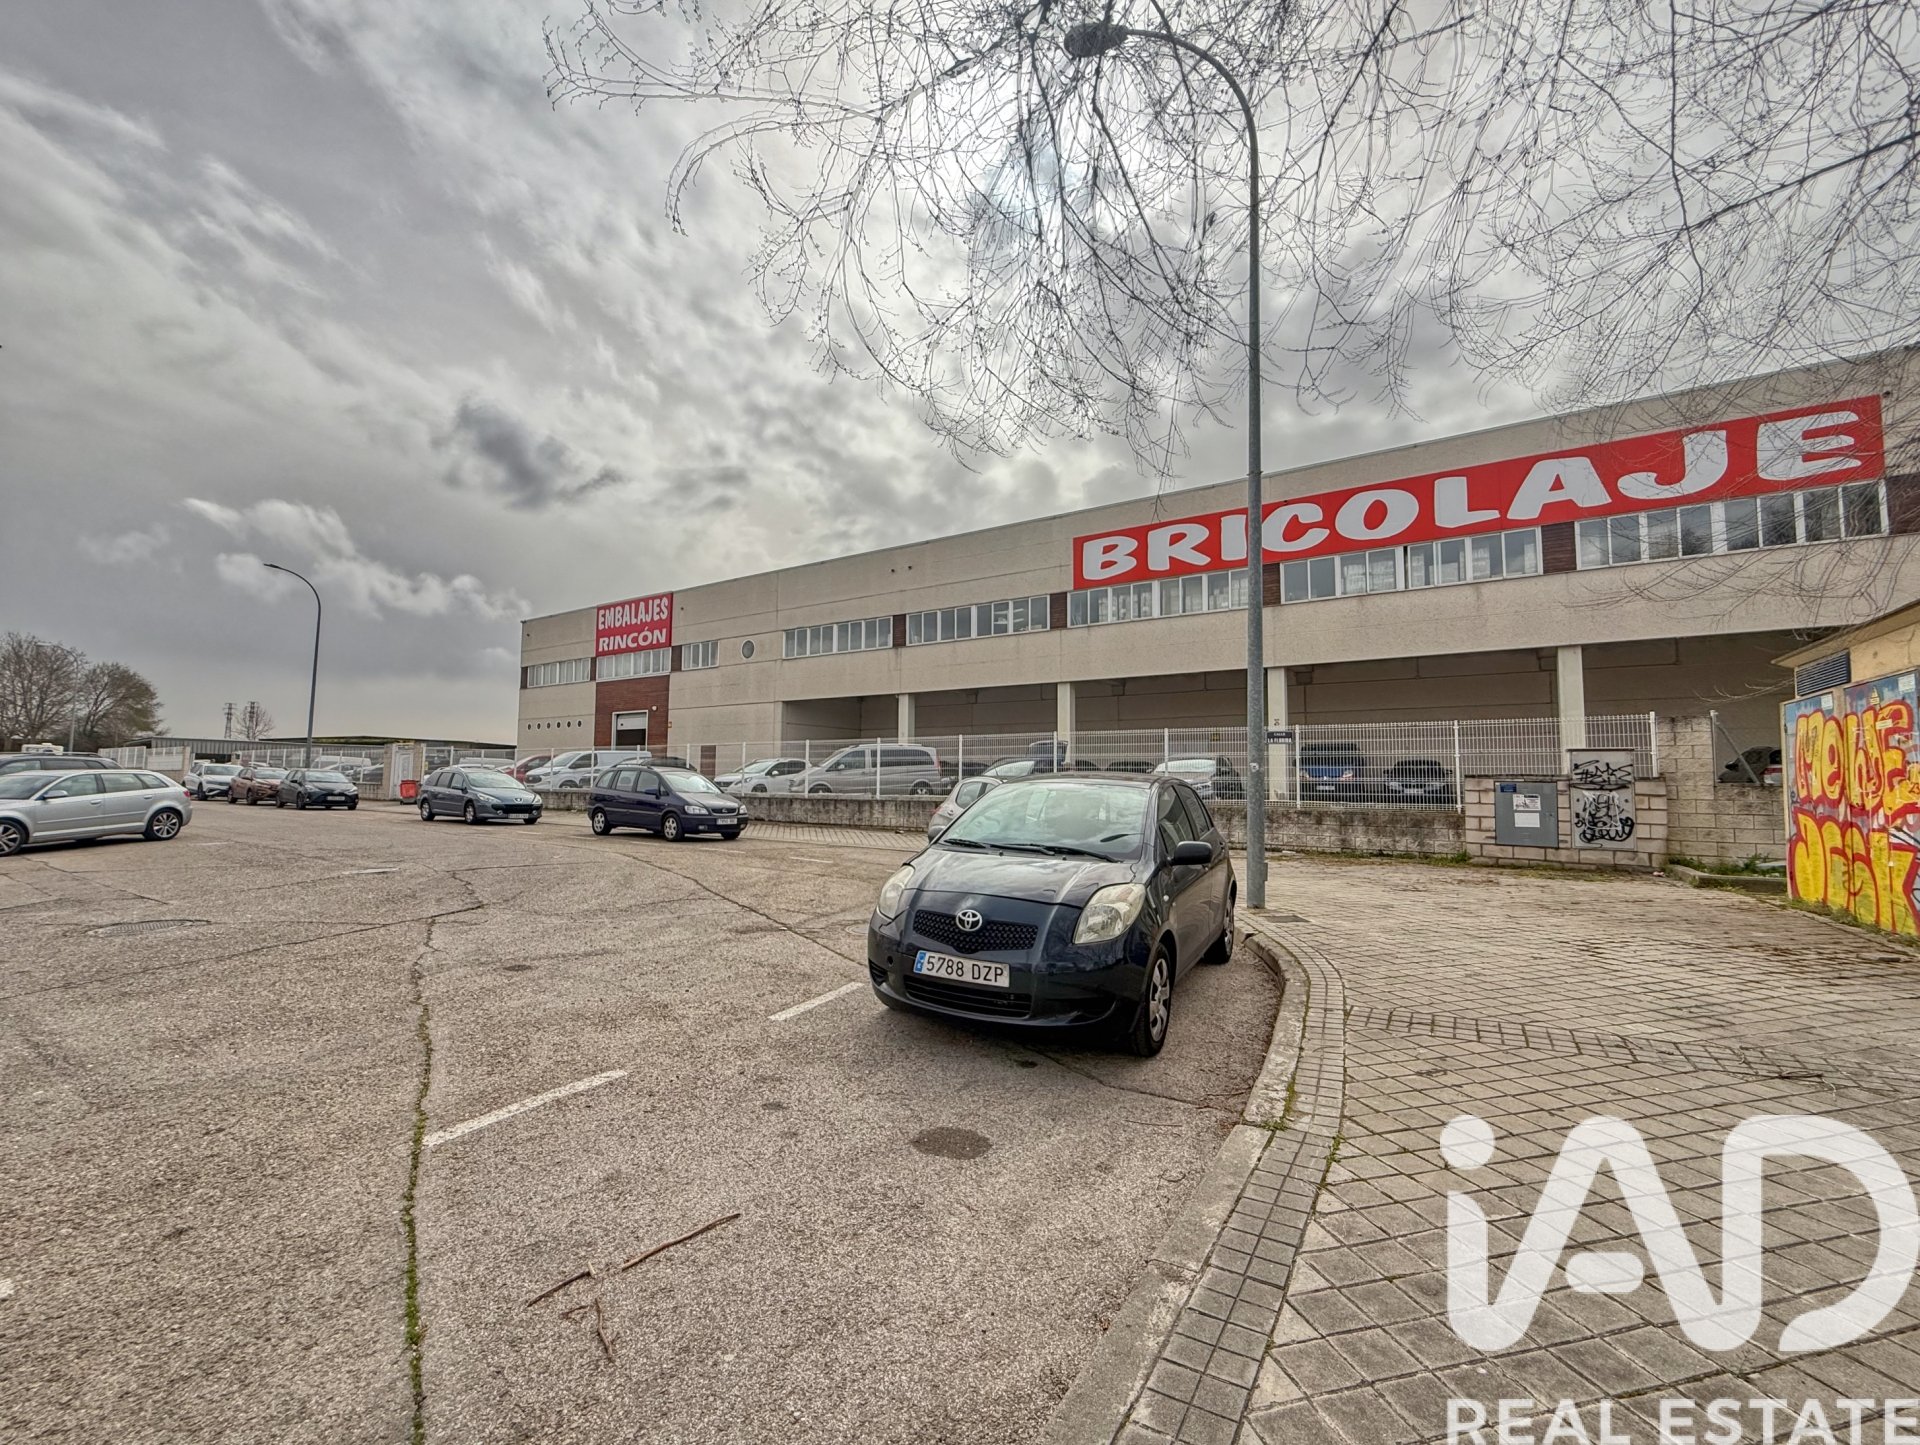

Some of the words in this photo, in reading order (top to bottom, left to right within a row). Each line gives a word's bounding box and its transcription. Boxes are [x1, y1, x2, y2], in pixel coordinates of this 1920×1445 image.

[1083, 410, 1862, 581] BRICOLAJE
[598, 596, 669, 630] EMBALAJES
[598, 627, 667, 652] RINCÓN
[926, 955, 964, 978] 5788
[971, 963, 1004, 983] DZP
